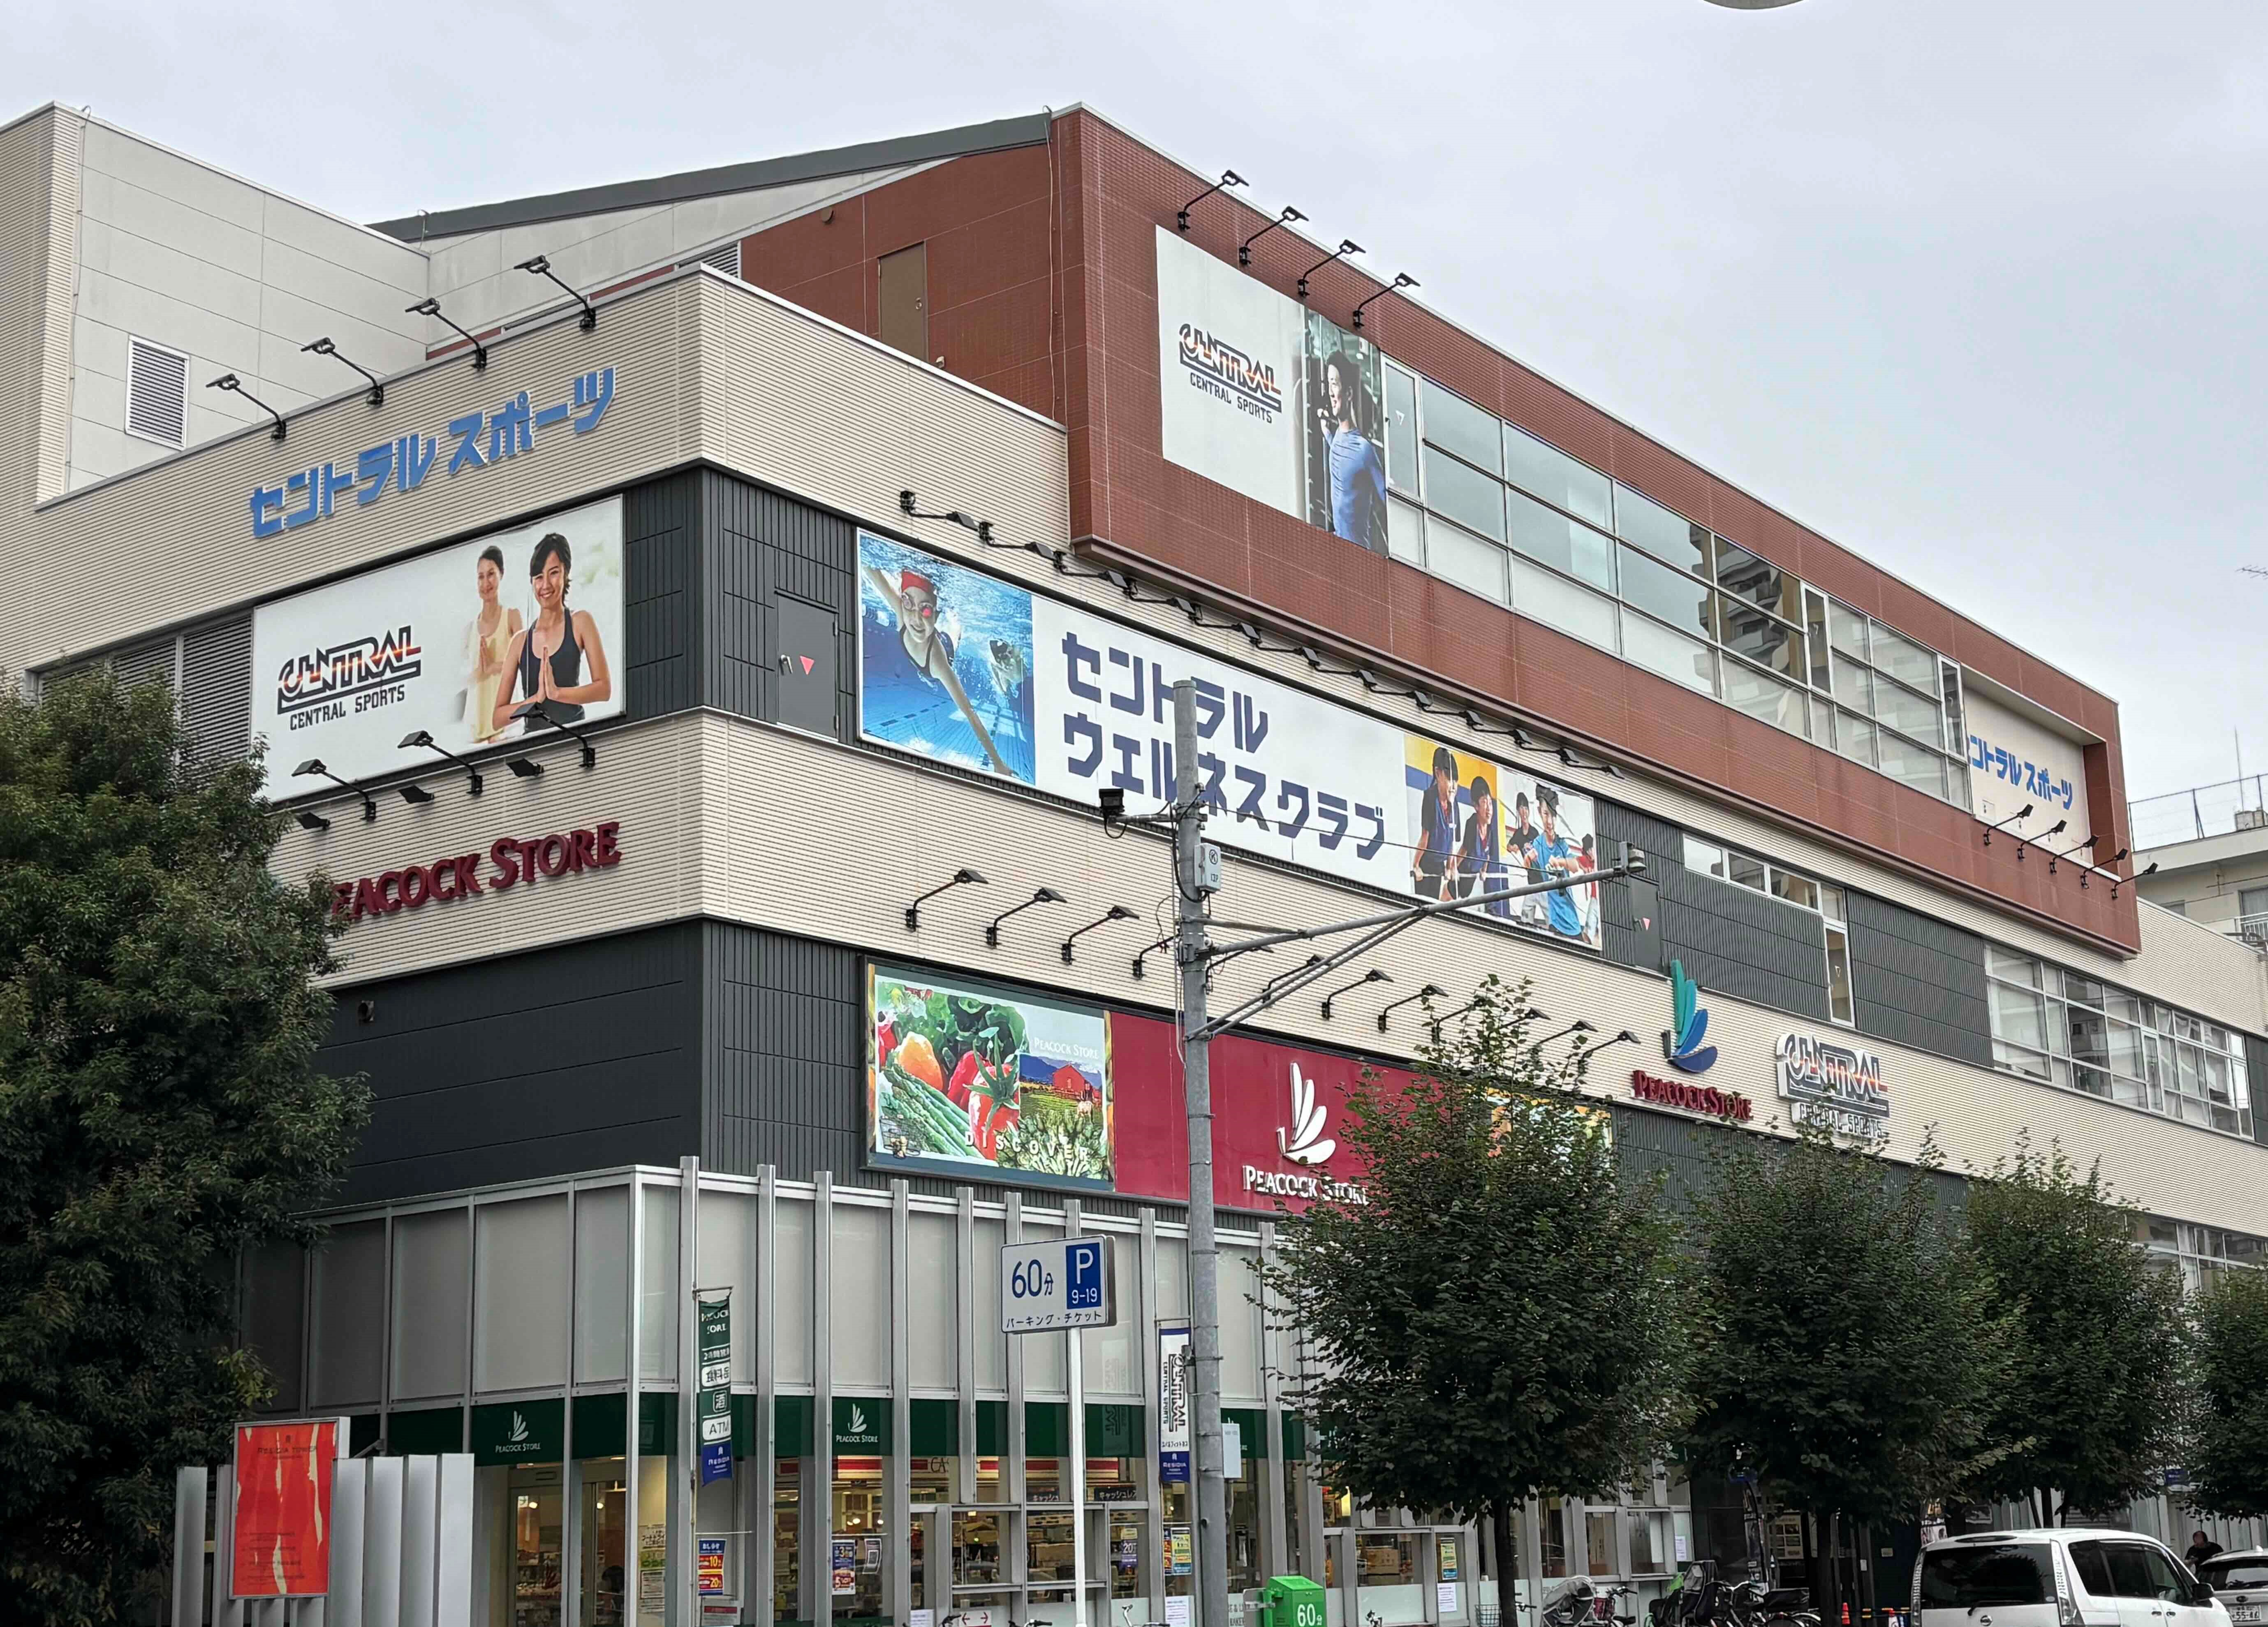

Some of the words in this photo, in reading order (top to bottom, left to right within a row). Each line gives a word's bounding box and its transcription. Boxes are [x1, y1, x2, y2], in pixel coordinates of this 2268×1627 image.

[1179, 324, 1282, 413] CENTRAL
[1190, 373, 1231, 404] CENTRAL
[1237, 396, 1273, 424] SPORTS
[278, 625, 421, 715] CENTRAL
[289, 700, 346, 731] CENTRAL
[355, 685, 405, 714] SPORTS
[1062, 632, 1268, 753] セントラル
[1968, 735, 2073, 810] ントラルスポーツ
[331, 853, 484, 921] EACOCK
[489, 822, 622, 889] STORE
[1034, 1037, 1071, 1055] PEACOCK
[1073, 1044, 1099, 1059] STORE
[1633, 1070, 1705, 1110] PEACOCK
[1705, 1086, 1753, 1121] STORE
[1781, 1033, 1889, 1117] CENTRAL
[1847, 1114, 1883, 1138] SPORTS
[1243, 1165, 1318, 1198] PEACOCK
[1012, 1260, 1053, 1298] 60分
[1076, 1249, 1093, 1284] P
[1072, 1288, 1097, 1304] 9-19
[1007, 1311, 1102, 1328] パーキング・チケット
[495, 1444, 521, 1453] PEACOCK
[836, 1435, 861, 1443] PEACOCK
